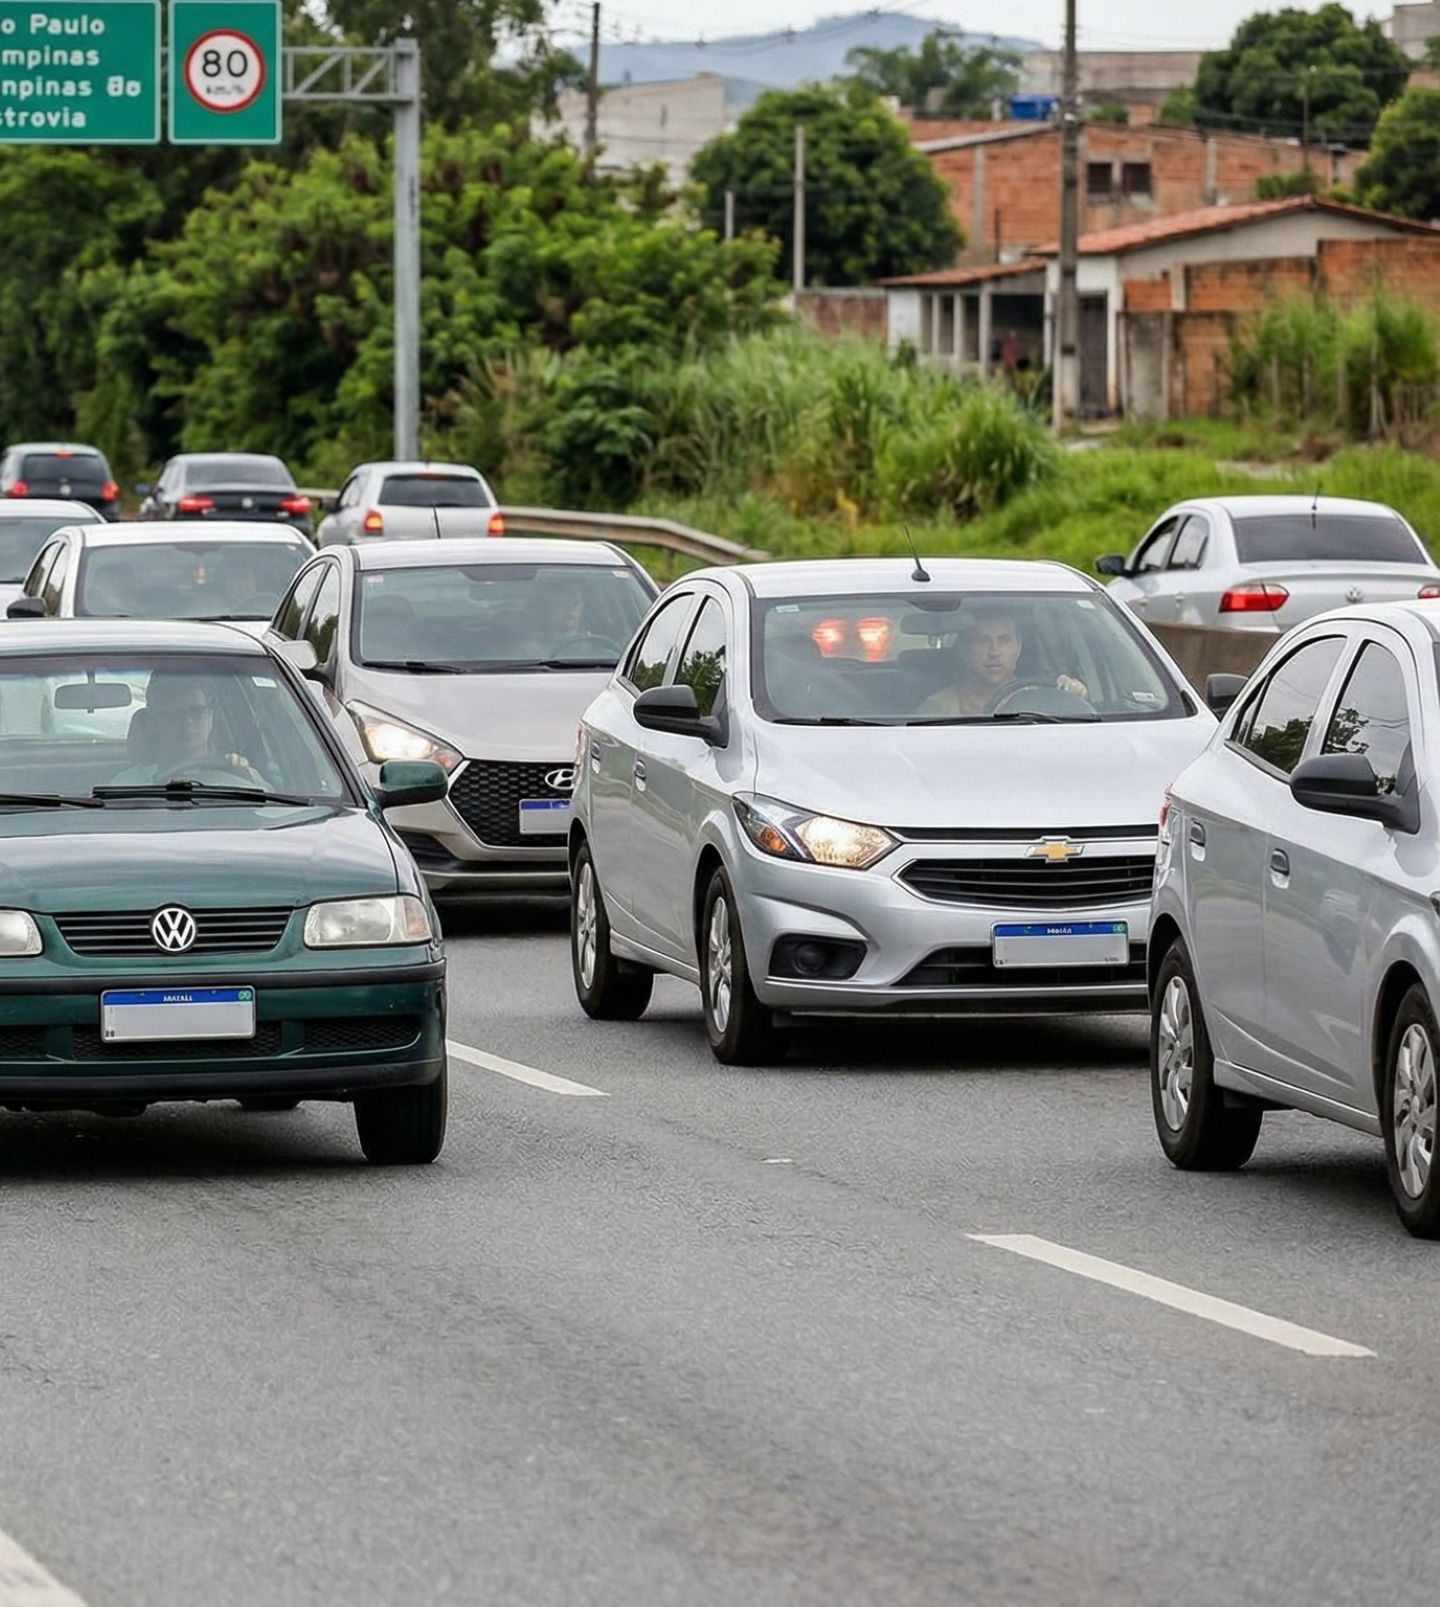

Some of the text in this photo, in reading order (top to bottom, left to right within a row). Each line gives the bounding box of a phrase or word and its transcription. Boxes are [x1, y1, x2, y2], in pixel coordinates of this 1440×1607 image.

[30, 13, 105, 35] Paulo
[202, 49, 248, 78] 80
[152, 907, 196, 952] VW
